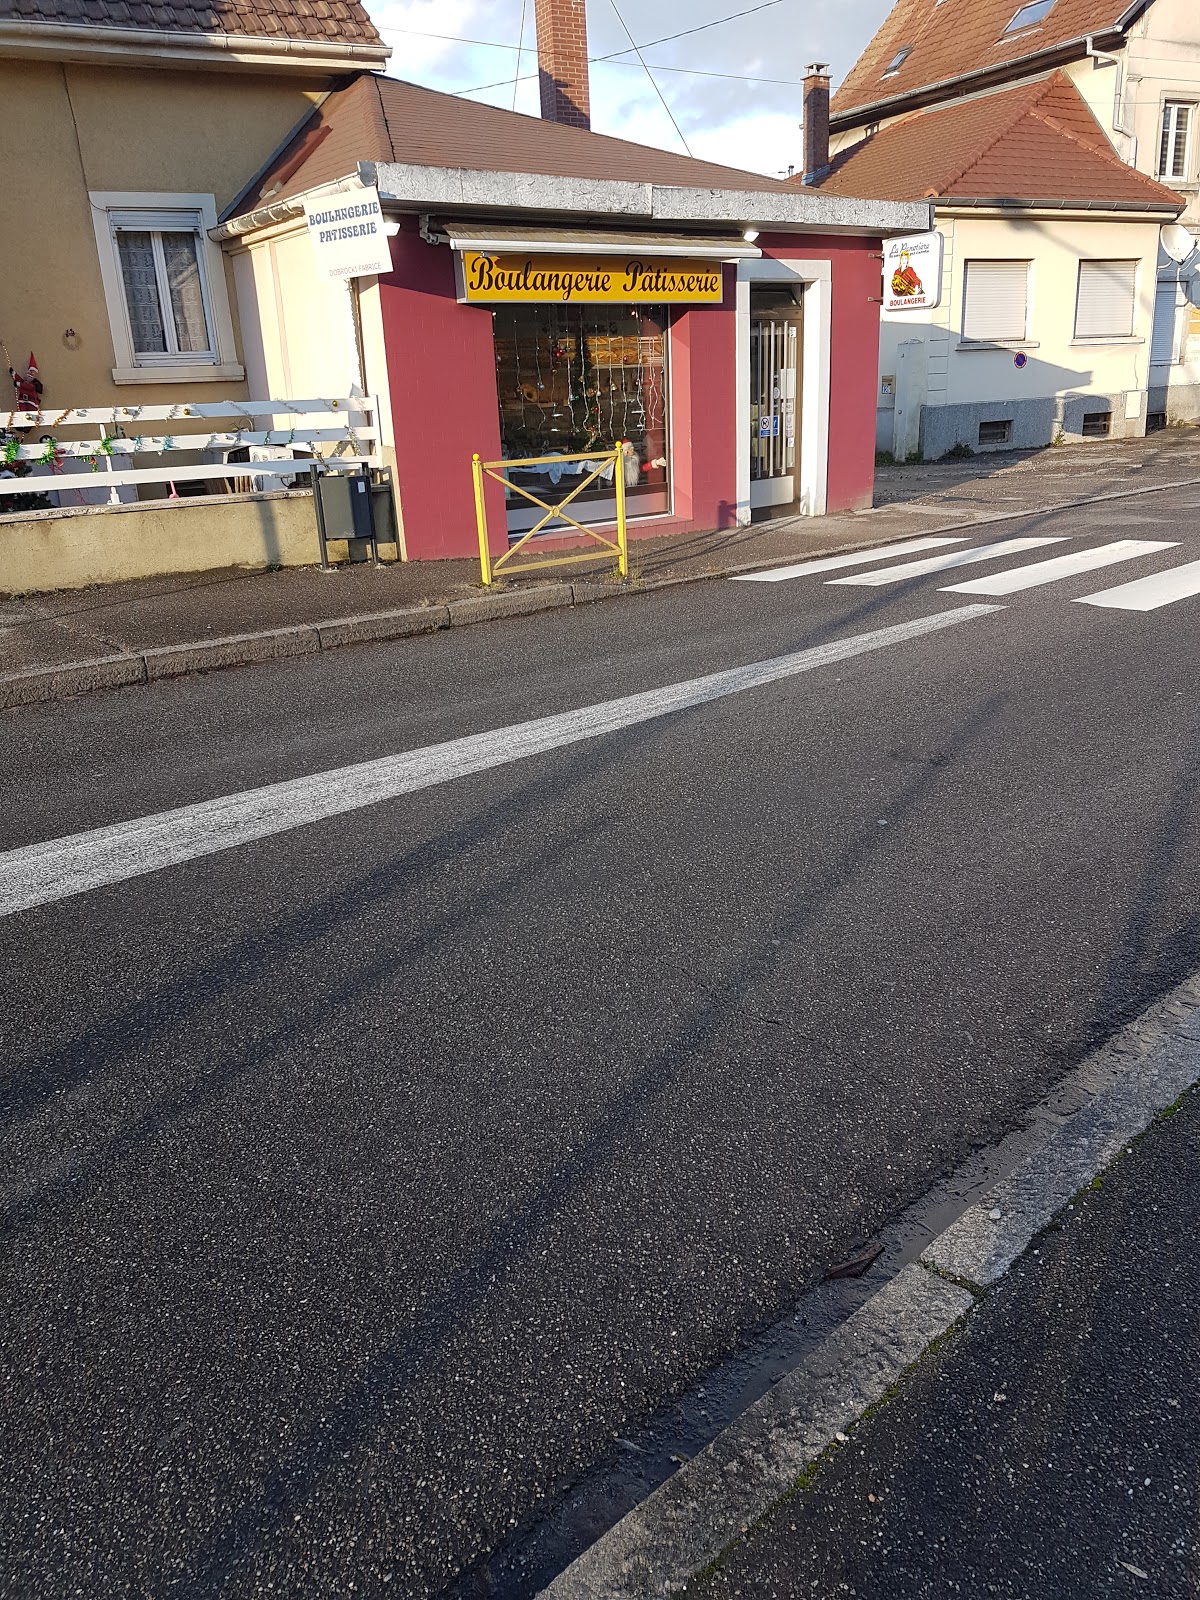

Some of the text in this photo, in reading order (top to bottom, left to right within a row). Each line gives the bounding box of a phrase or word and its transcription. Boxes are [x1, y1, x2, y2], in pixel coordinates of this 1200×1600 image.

[308, 201, 380, 226] BOULANGERIE
[319, 221, 378, 243] PATISSERIE
[468, 256, 720, 301] Boulangerie Pâtisserie
[889, 296, 926, 307] BOULANGERIE
